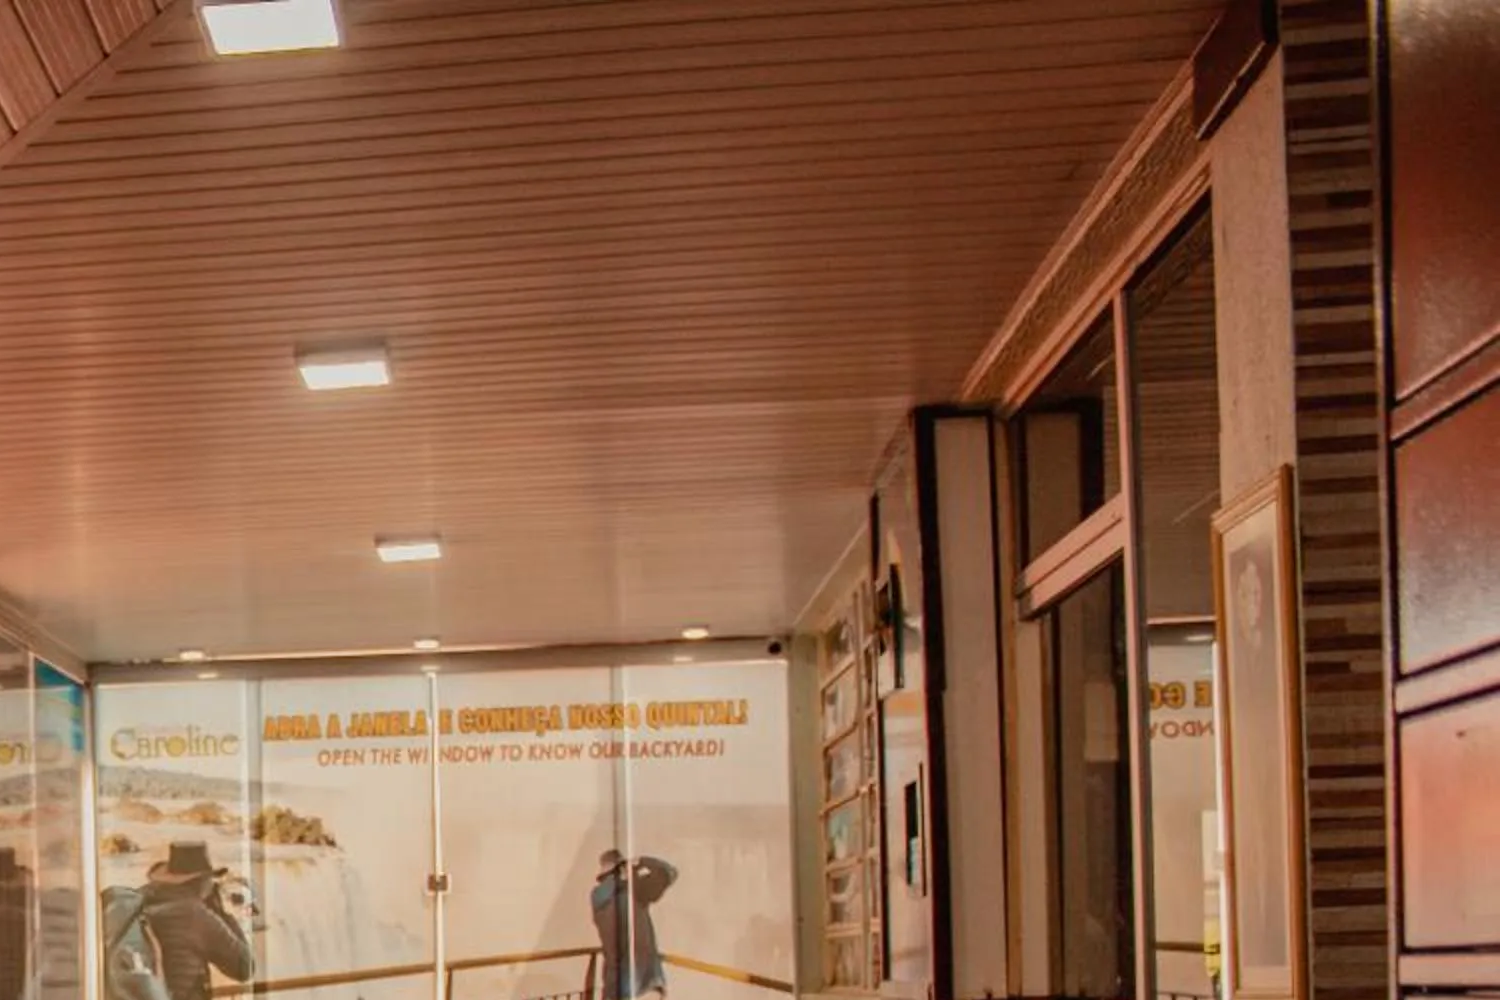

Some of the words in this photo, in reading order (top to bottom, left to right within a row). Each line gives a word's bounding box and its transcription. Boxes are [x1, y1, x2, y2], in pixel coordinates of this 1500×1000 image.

[263, 713, 321, 742] ABRA
[326, 713, 342, 738] A
[346, 709, 428, 738] JANELA
[457, 704, 563, 737] CONHEÇA
[568, 702, 641, 731] NOSSO
[645, 698, 749, 730] QUINTAL!
[110, 725, 240, 762] Caroline
[317, 748, 365, 767] OPEN
[370, 748, 402, 766] THE
[407, 745, 494, 765] WINDOW
[500, 743, 523, 762] TO
[528, 741, 583, 761] KNOW
[589, 740, 624, 760] OUR
[629, 738, 725, 759] BACKYARD!
